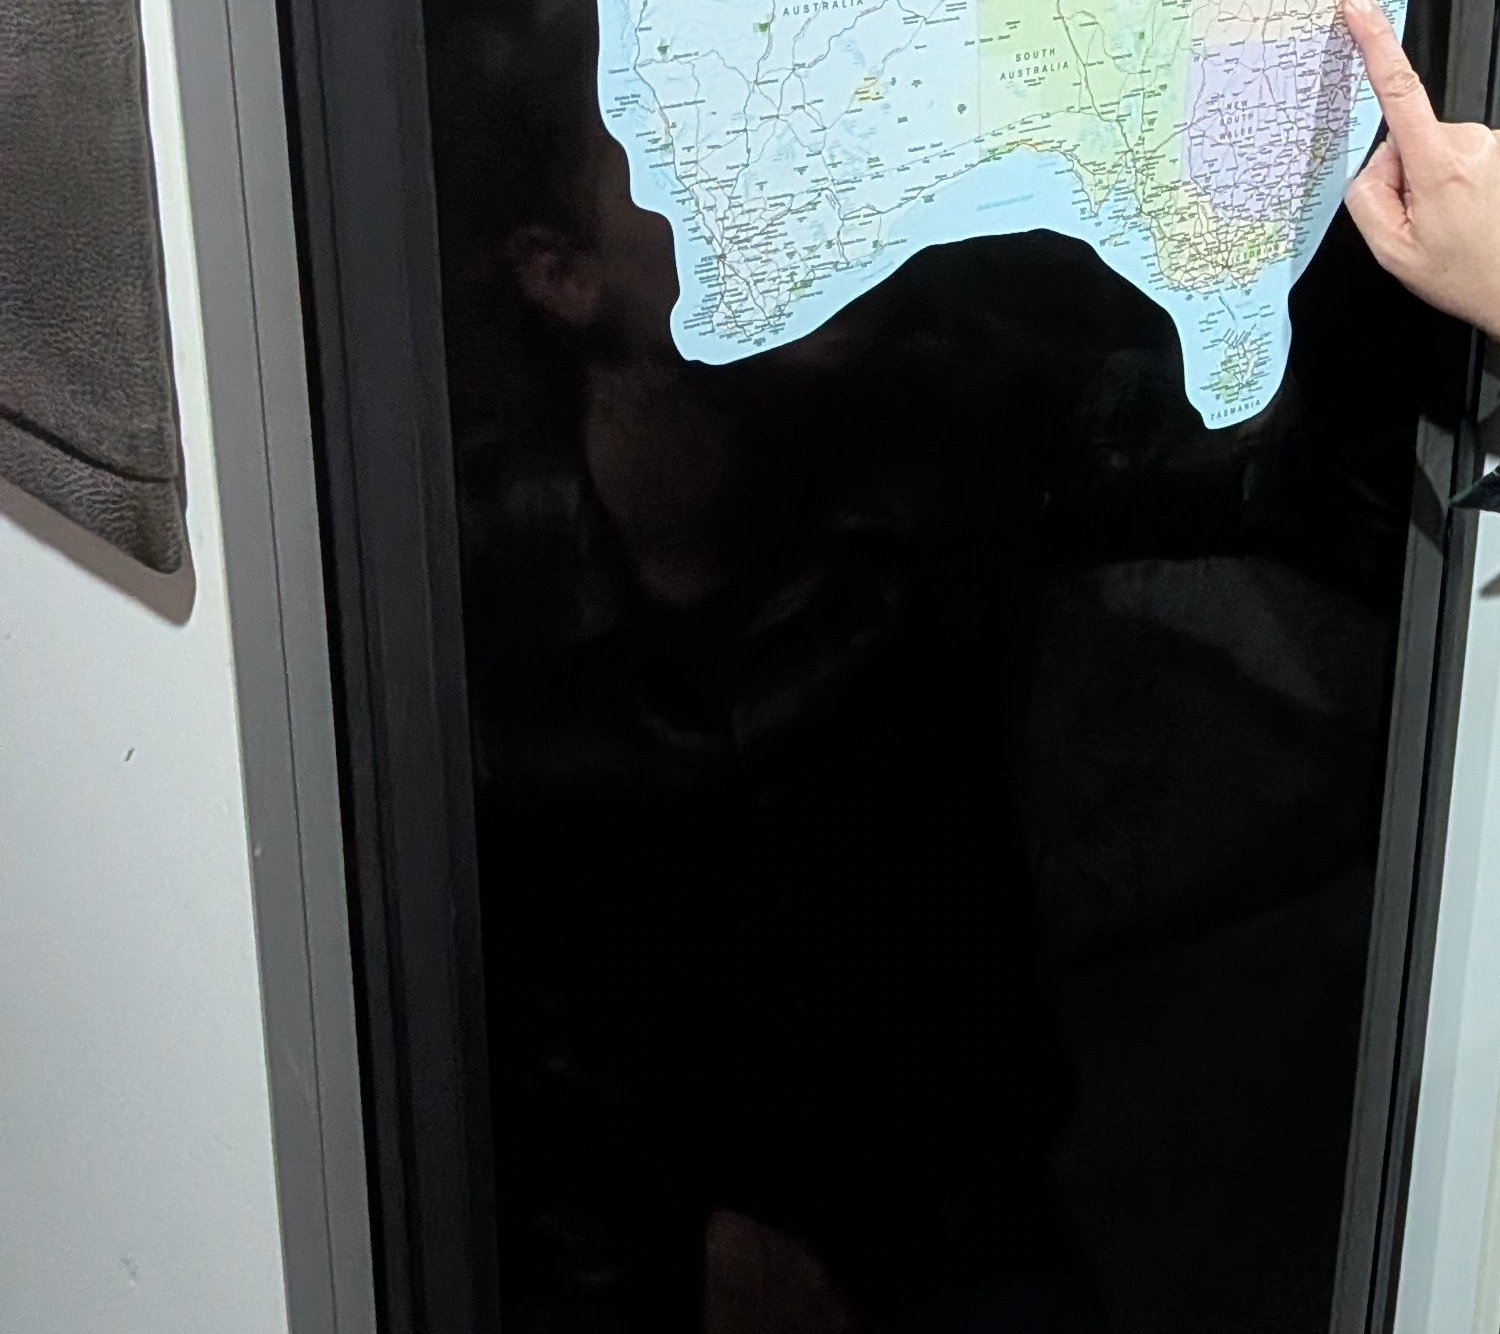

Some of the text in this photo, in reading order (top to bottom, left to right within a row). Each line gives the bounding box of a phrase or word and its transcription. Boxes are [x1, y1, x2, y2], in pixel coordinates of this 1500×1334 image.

[1015, 48, 1056, 63] SOUTH
[1000, 61, 1070, 81] AUSTRALIA
[1226, 100, 1248, 110] NEW
[1220, 113, 1254, 127] SOUTH
[1210, 399, 1261, 421] TASMANIA
